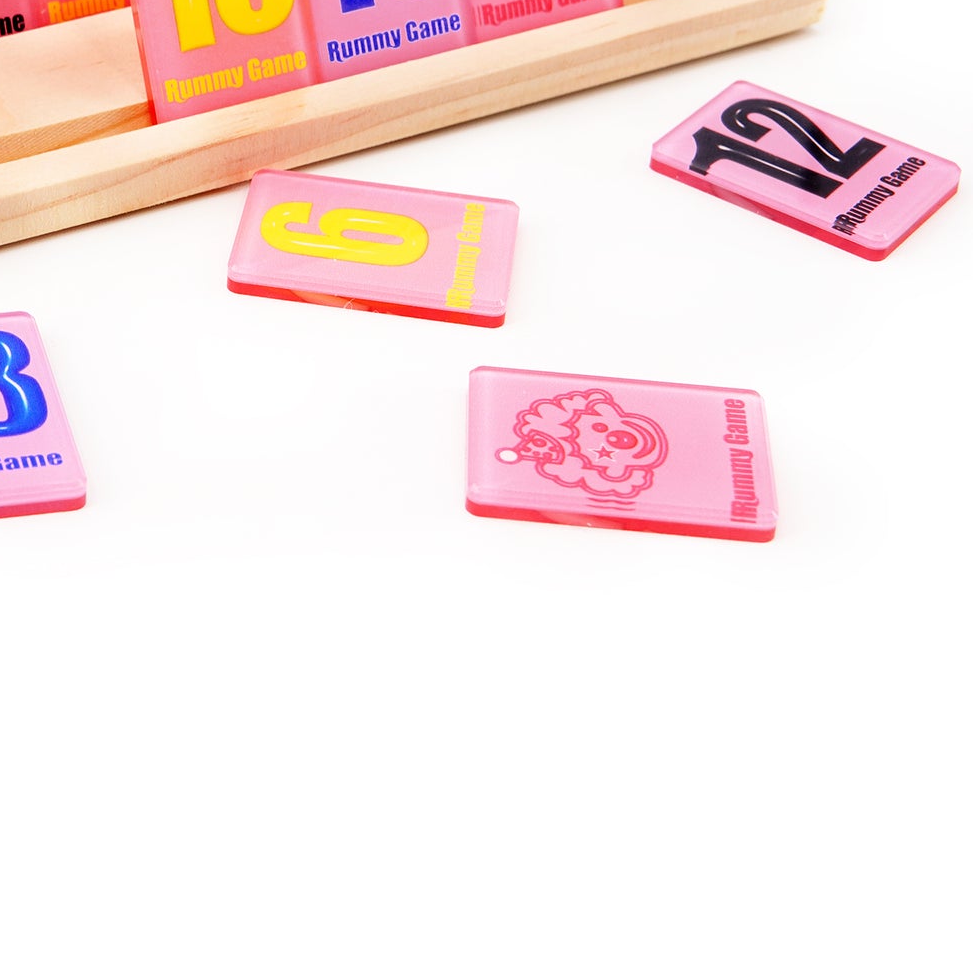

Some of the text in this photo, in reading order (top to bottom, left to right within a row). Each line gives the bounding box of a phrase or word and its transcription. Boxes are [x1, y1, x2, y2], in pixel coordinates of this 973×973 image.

[327, 12, 461, 63] Rummy Game
[164, 48, 307, 104] Rummy Game
[689, 98, 887, 199] 12
[880, 155, 927, 188] Game
[260, 200, 430, 267] 6
[455, 202, 486, 244] Game
[723, 398, 750, 445] Game
